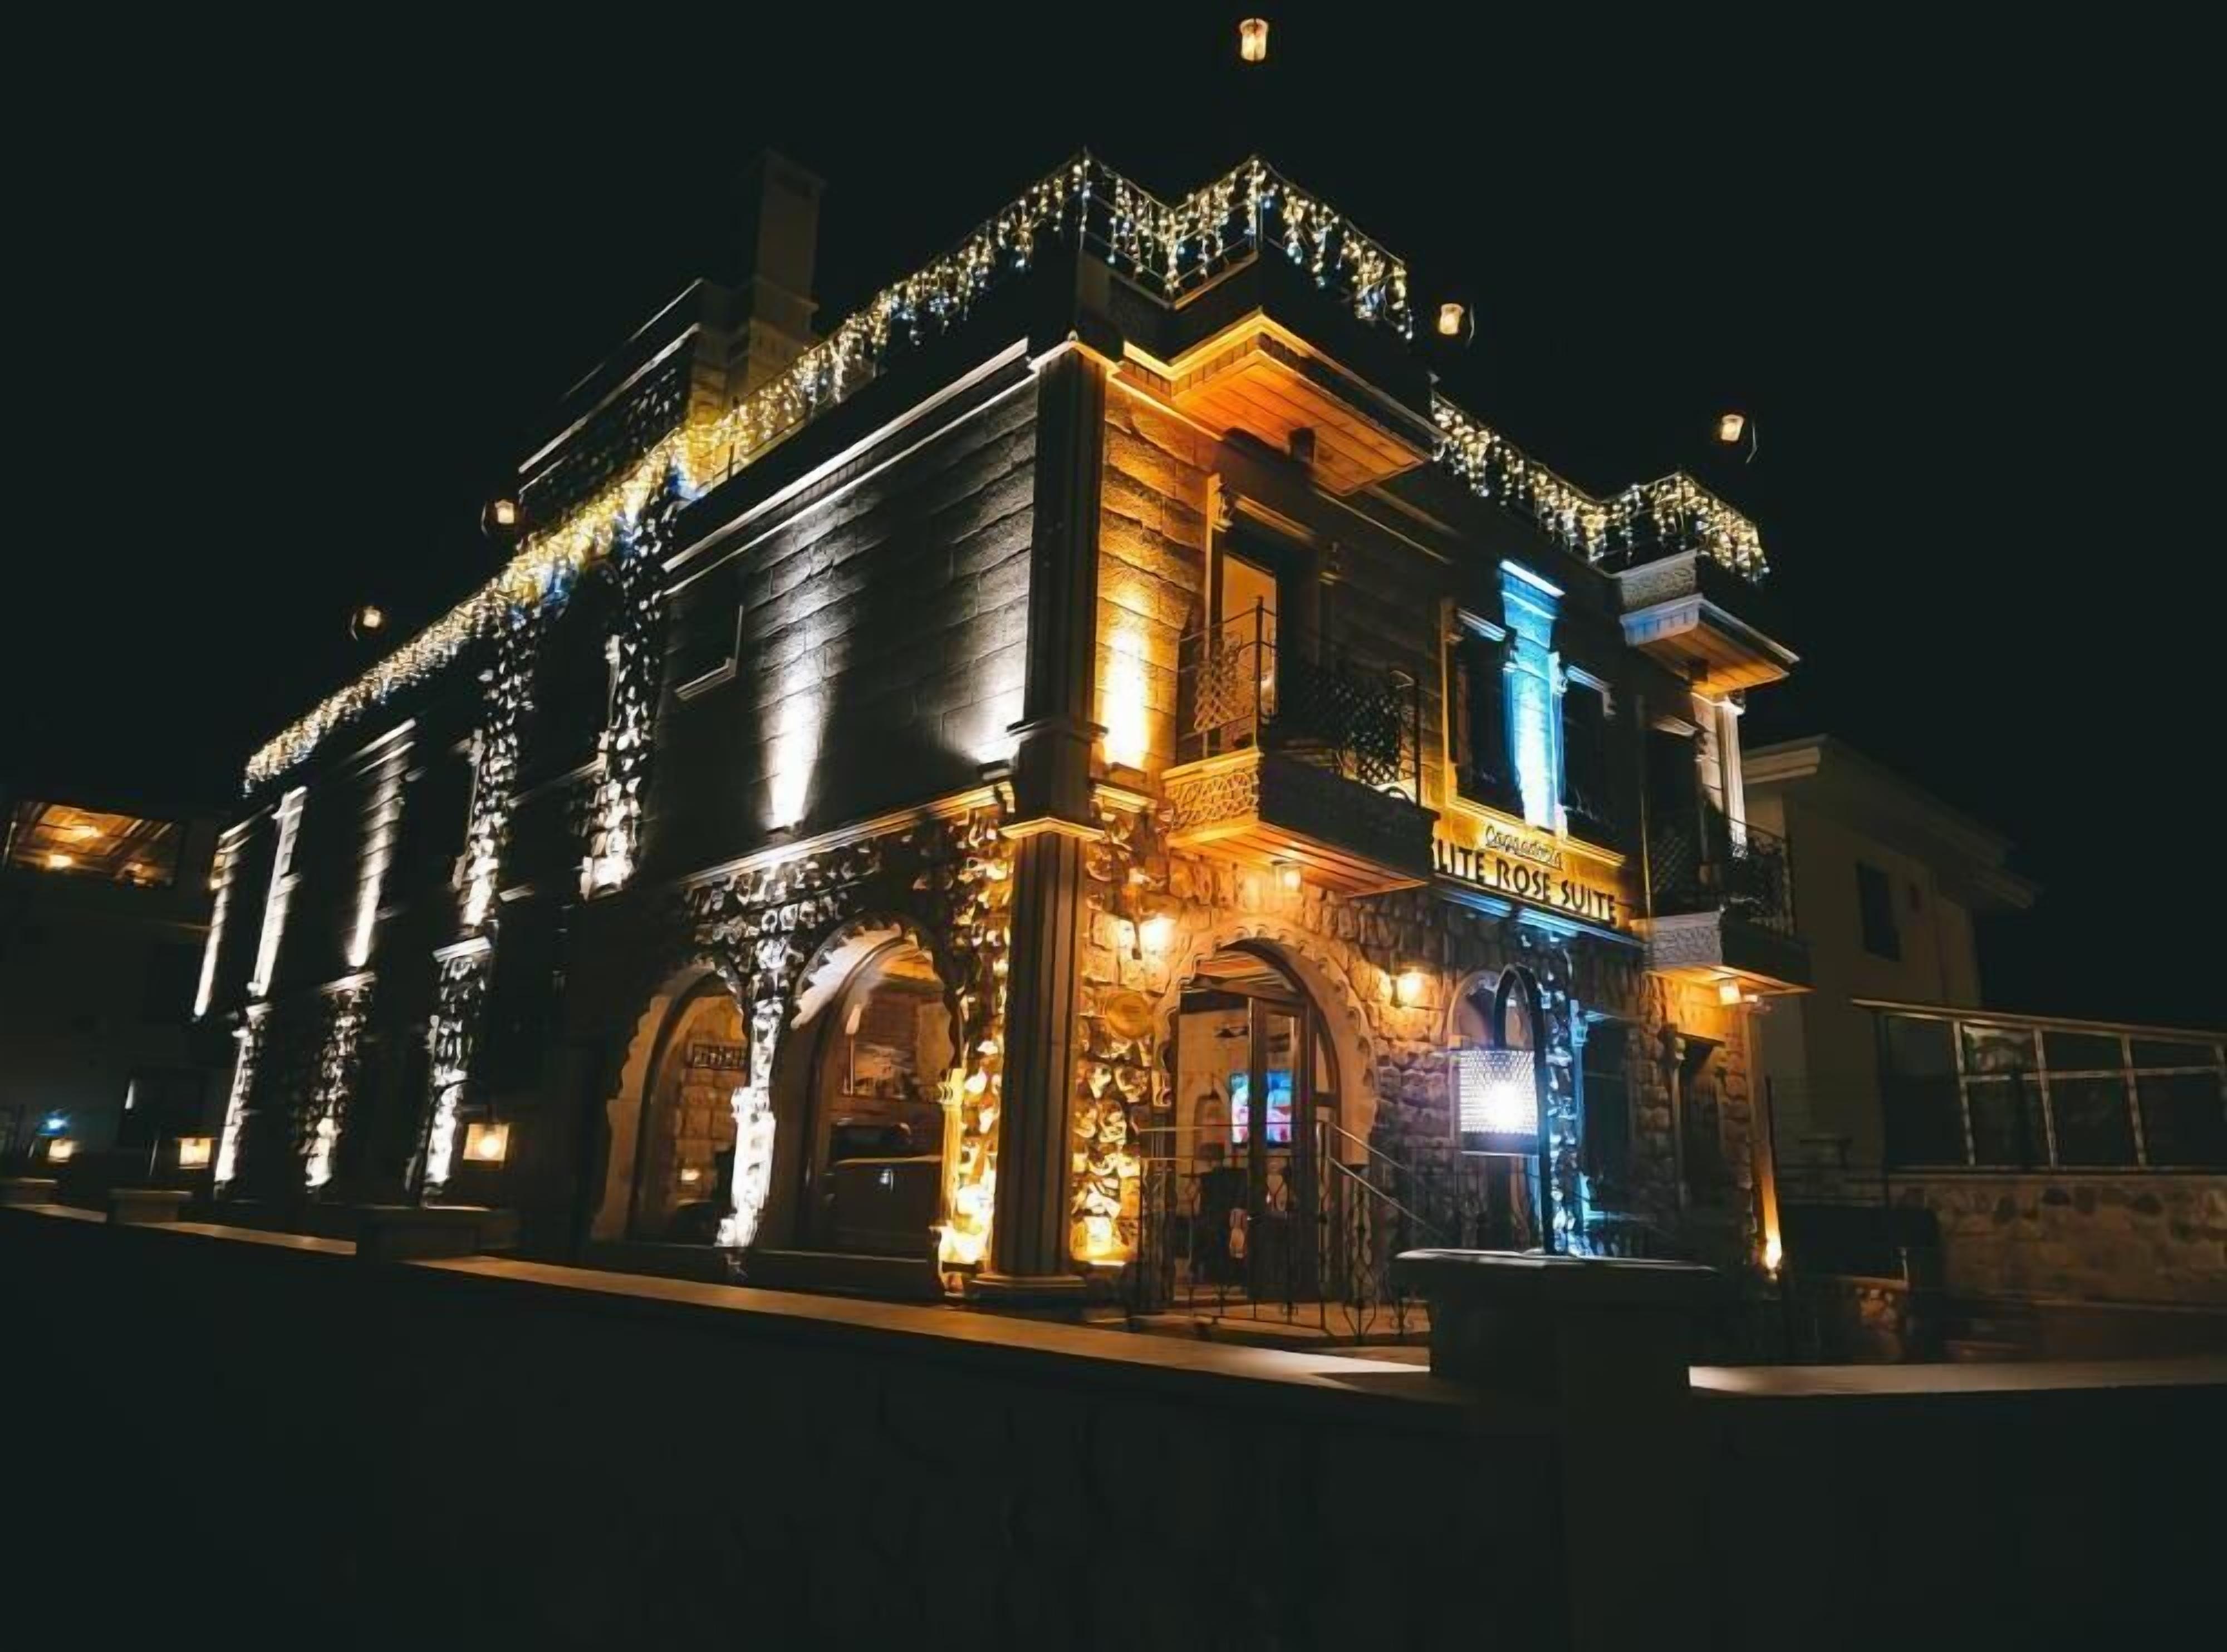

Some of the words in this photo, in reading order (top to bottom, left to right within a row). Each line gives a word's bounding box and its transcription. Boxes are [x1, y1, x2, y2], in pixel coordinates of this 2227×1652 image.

[1435, 838, 1484, 884] LITE
[1496, 857, 1551, 903] ROSE
[1561, 879, 1616, 925] SUITE
